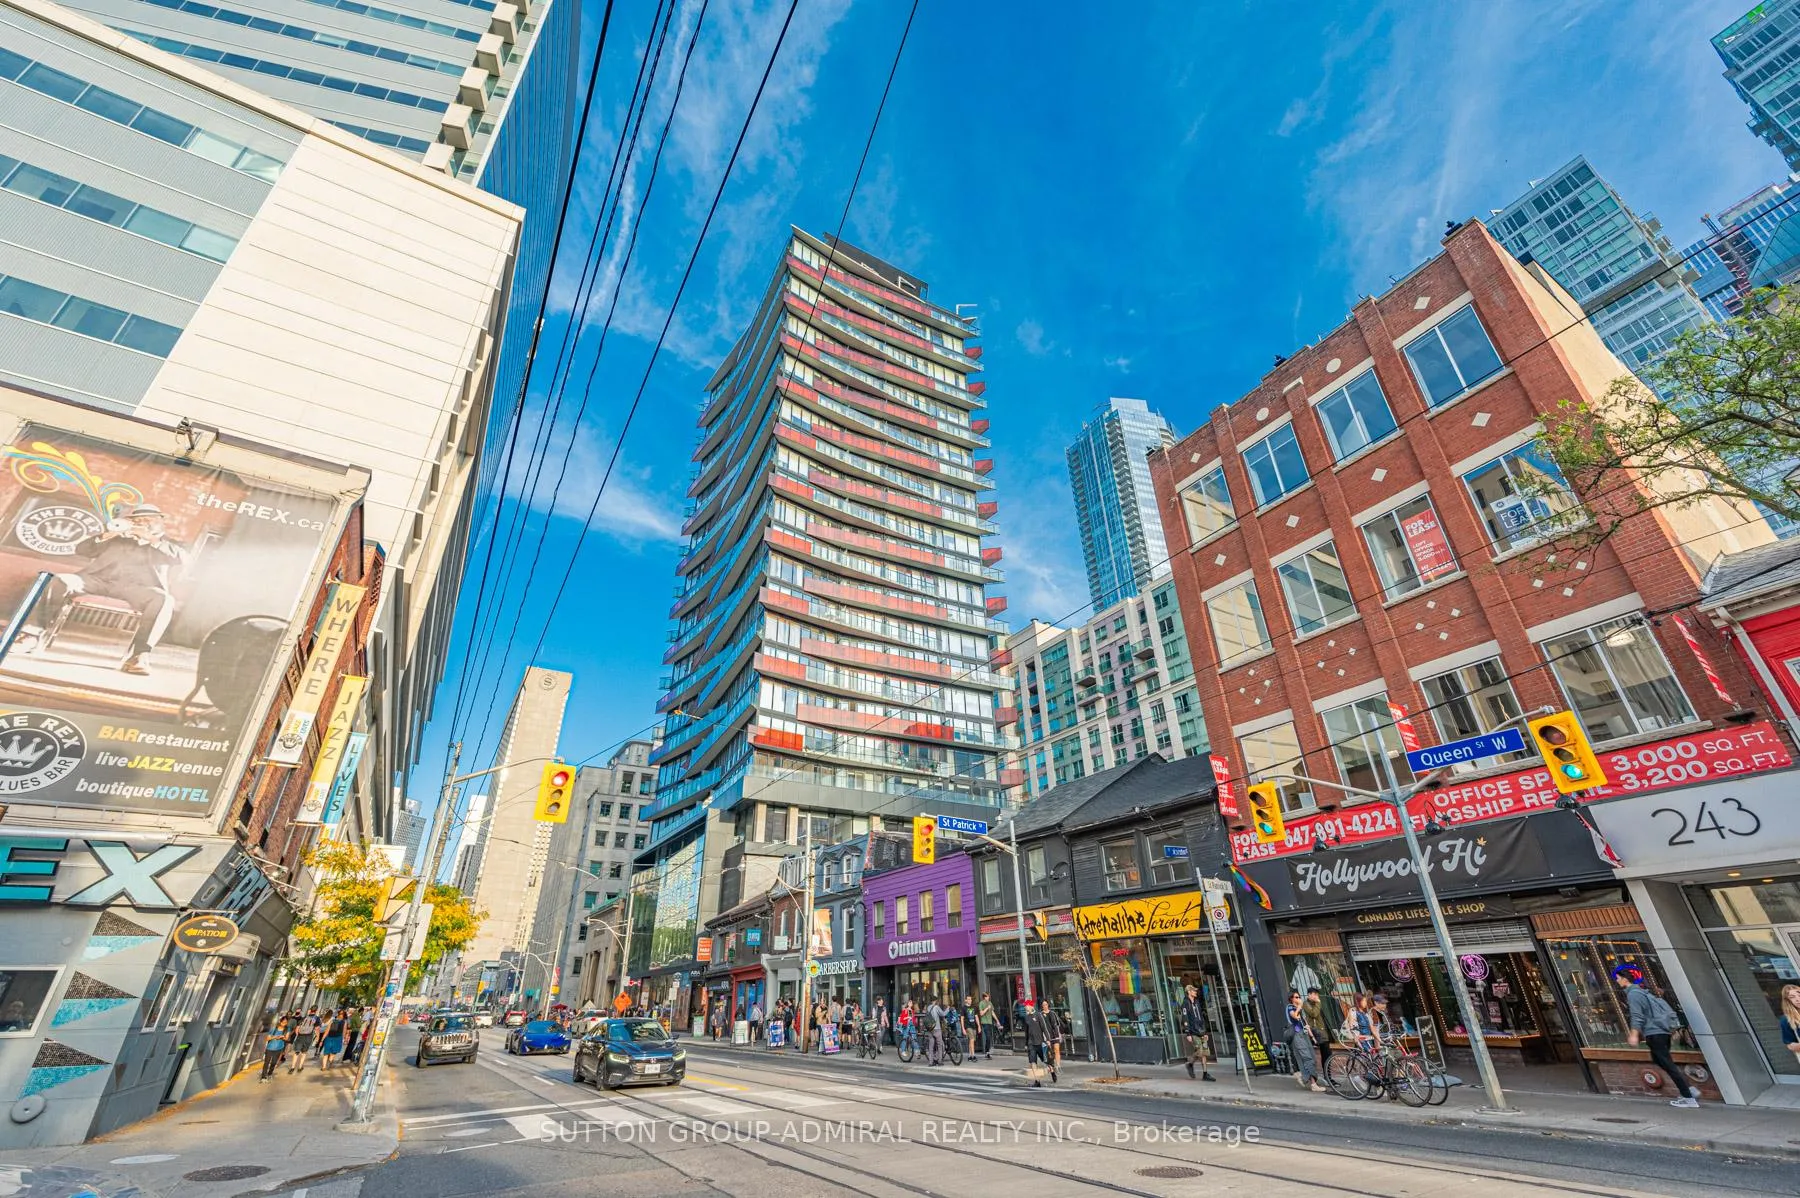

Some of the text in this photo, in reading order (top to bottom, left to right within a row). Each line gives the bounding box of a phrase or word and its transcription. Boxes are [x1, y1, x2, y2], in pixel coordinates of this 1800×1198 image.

[29, 508, 100, 533] THE REX
[196, 492, 324, 532] theREX.ca
[304, 597, 358, 696] WHERE
[40, 717, 81, 749] REX
[98, 725, 230, 752] BARrestaurant
[322, 691, 353, 760] JAZZ
[95, 752, 224, 776] liveJAZZvenue
[1420, 745, 1474, 767] Queen
[1491, 735, 1507, 751] W
[1611, 741, 1698, 772] 3,000
[44, 759, 74, 780] BAR
[329, 743, 359, 812] LIVES
[1619, 760, 1708, 790] 3,200
[75, 778, 210, 803] boutiqueHOTEL
[1434, 780, 1513, 808] OFFICE
[942, 818, 950, 827] St
[952, 819, 977, 831] Patrick
[1233, 808, 1397, 849] FOR 647-891-4224
[1650, 797, 1761, 847] 243
[1235, 842, 1277, 861] LEASE
[1296, 836, 1487, 895] Hollywood Hi
[1075, 900, 1200, 940] Adrenaline Toronto
[1357, 911, 1404, 924] CANNABIS
[1456, 902, 1485, 915] SHOP
[197, 929, 220, 938] PATIO
[819, 960, 858, 976] ARBERSHOP
